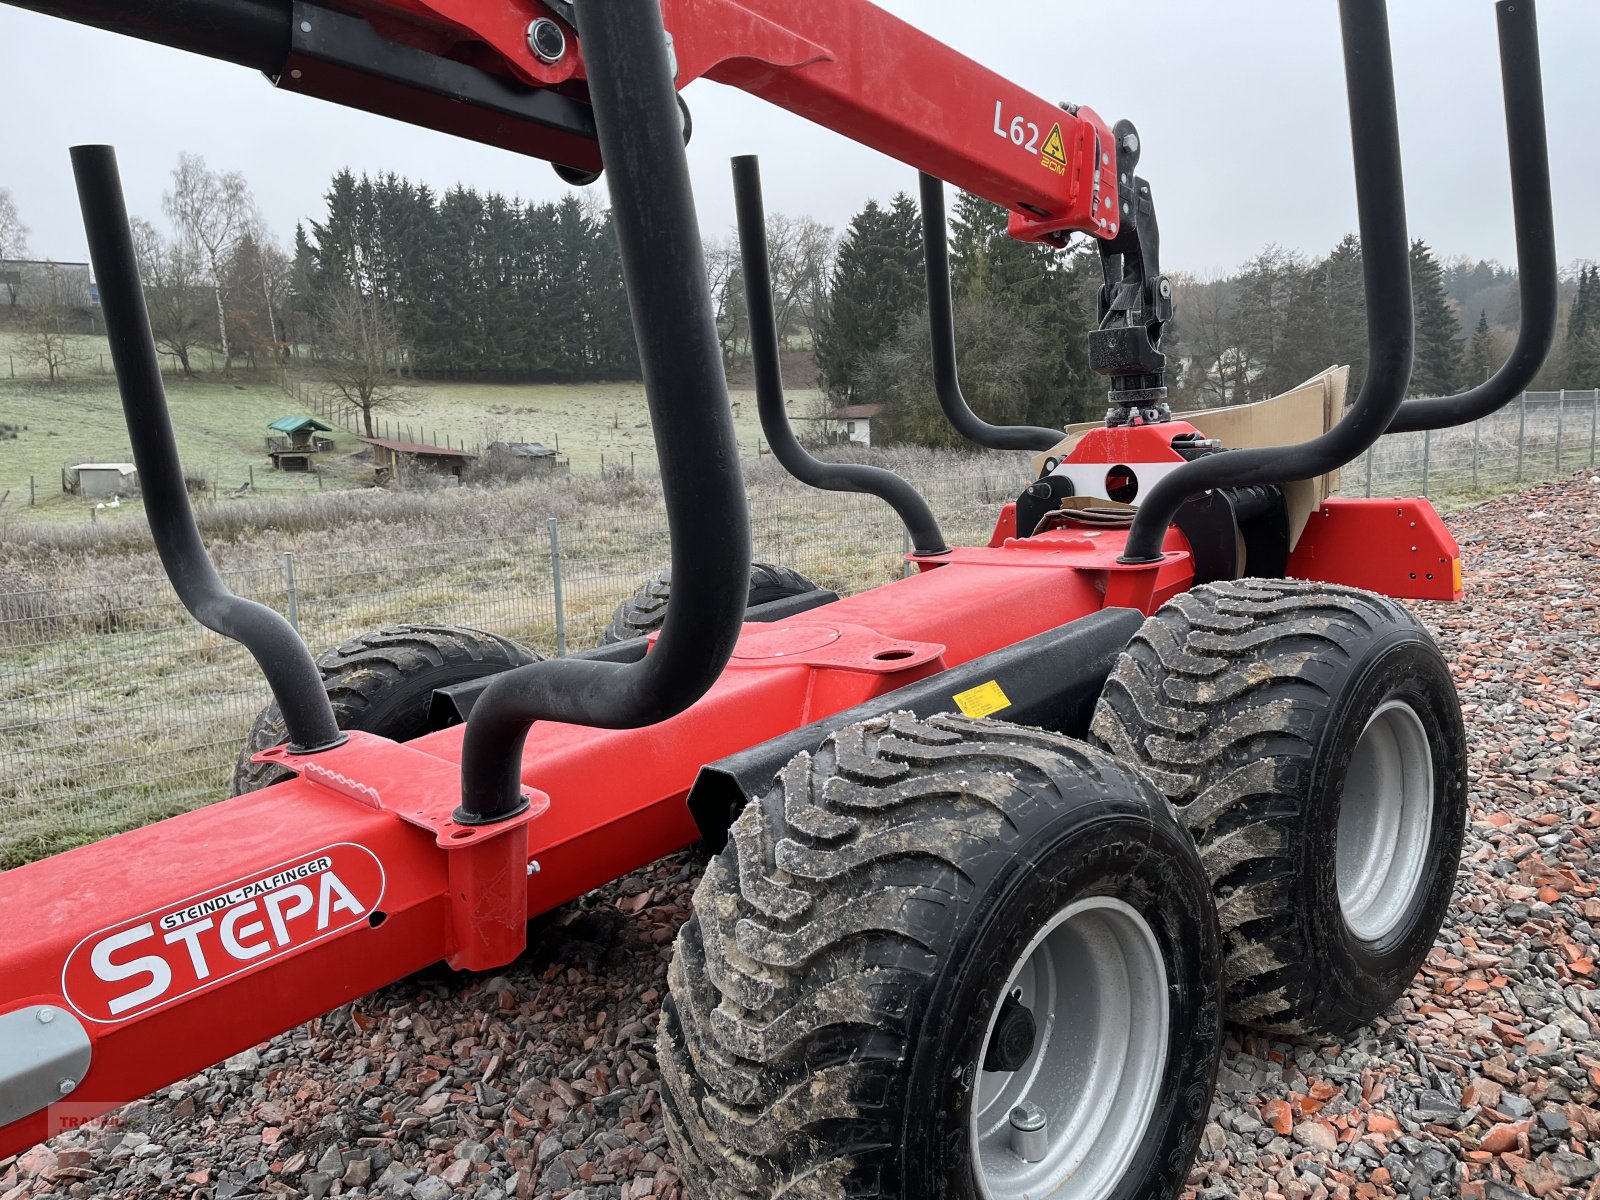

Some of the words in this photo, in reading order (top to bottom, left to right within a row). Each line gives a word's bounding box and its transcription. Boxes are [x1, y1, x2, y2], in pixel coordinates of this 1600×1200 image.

[993, 100, 1039, 155] L62
[1041, 156, 1066, 177] 20M
[164, 857, 330, 929] STEINDL-PALFINGER
[90, 870, 366, 1016] STEPA
